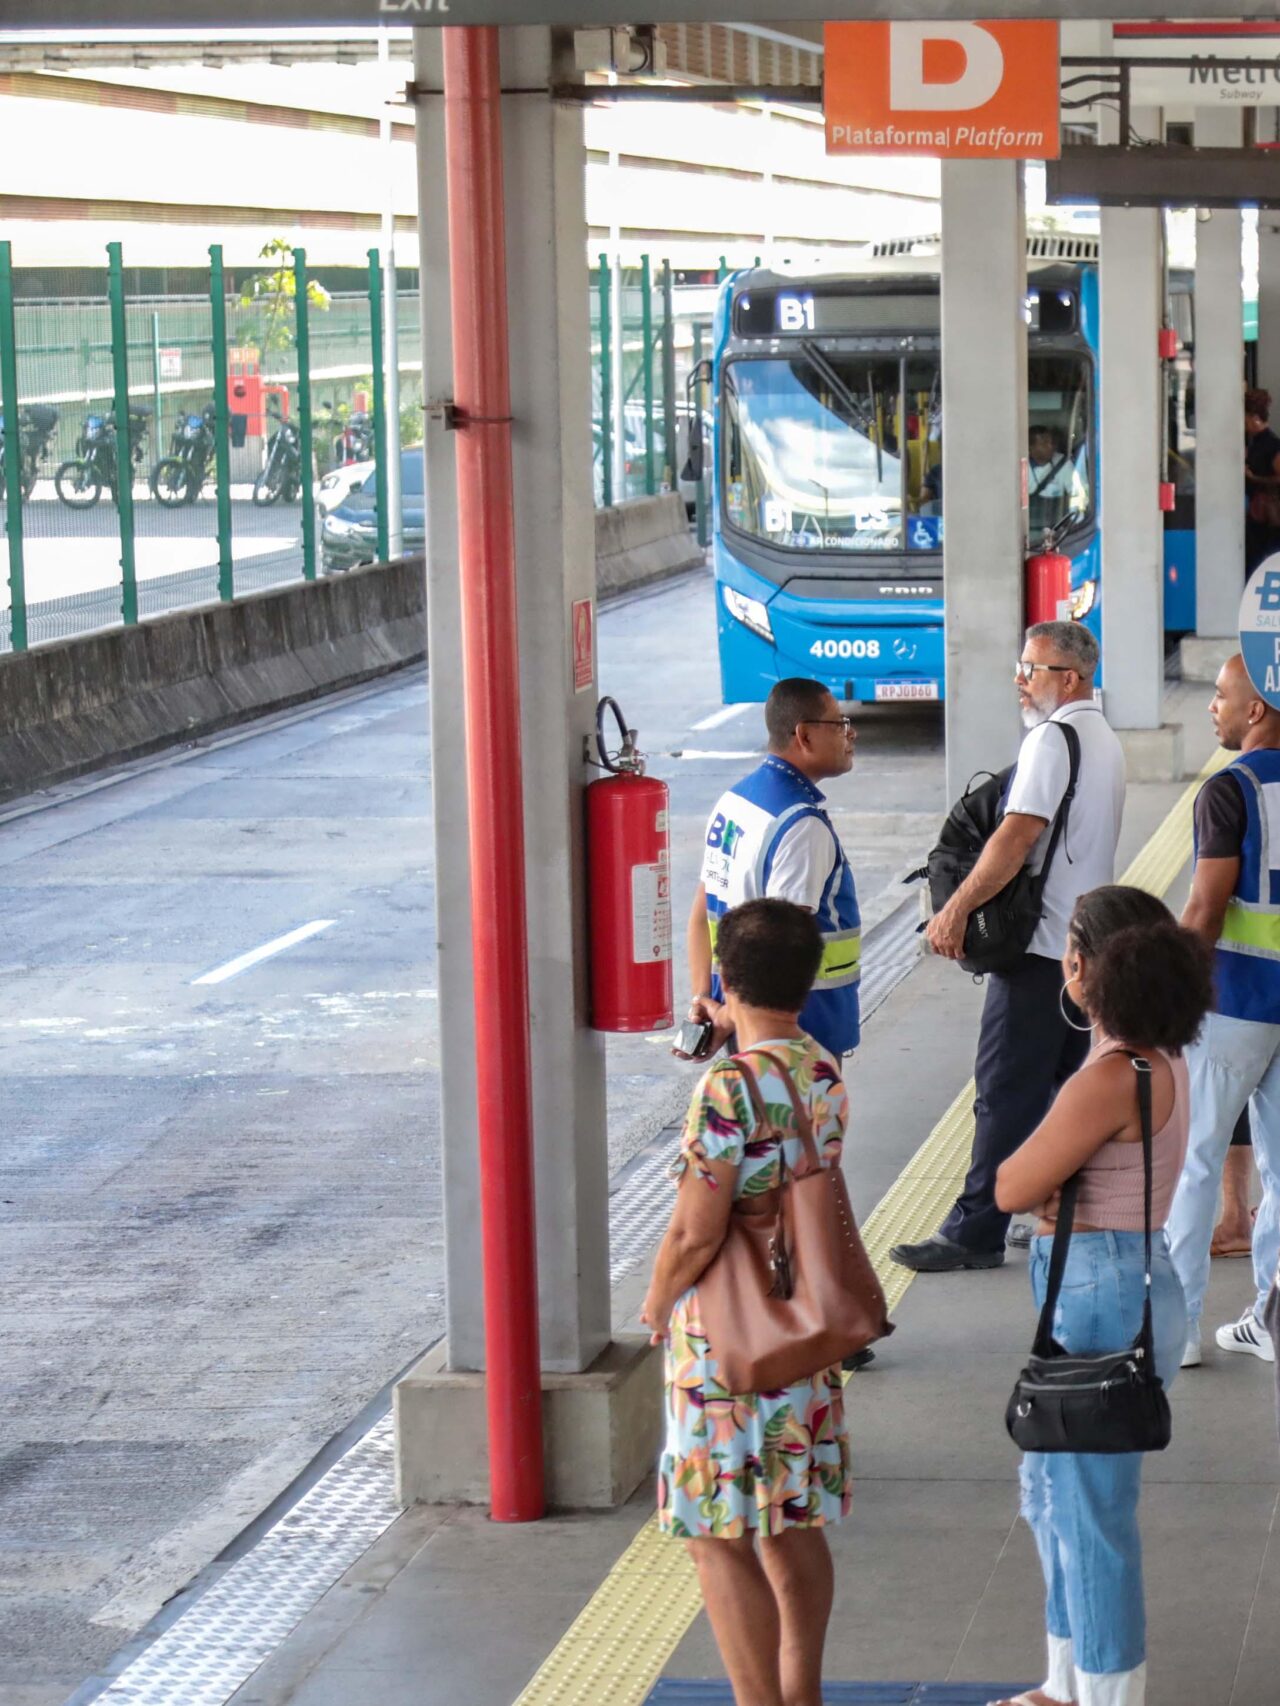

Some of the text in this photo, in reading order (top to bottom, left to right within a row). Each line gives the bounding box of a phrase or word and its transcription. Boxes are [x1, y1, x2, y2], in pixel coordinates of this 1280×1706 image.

[1219, 88, 1264, 100] Subway
[954, 126, 1044, 150] Platform
[779, 298, 815, 331] B1
[825, 536, 899, 547] CONDICIONADO
[809, 640, 880, 659] 40008
